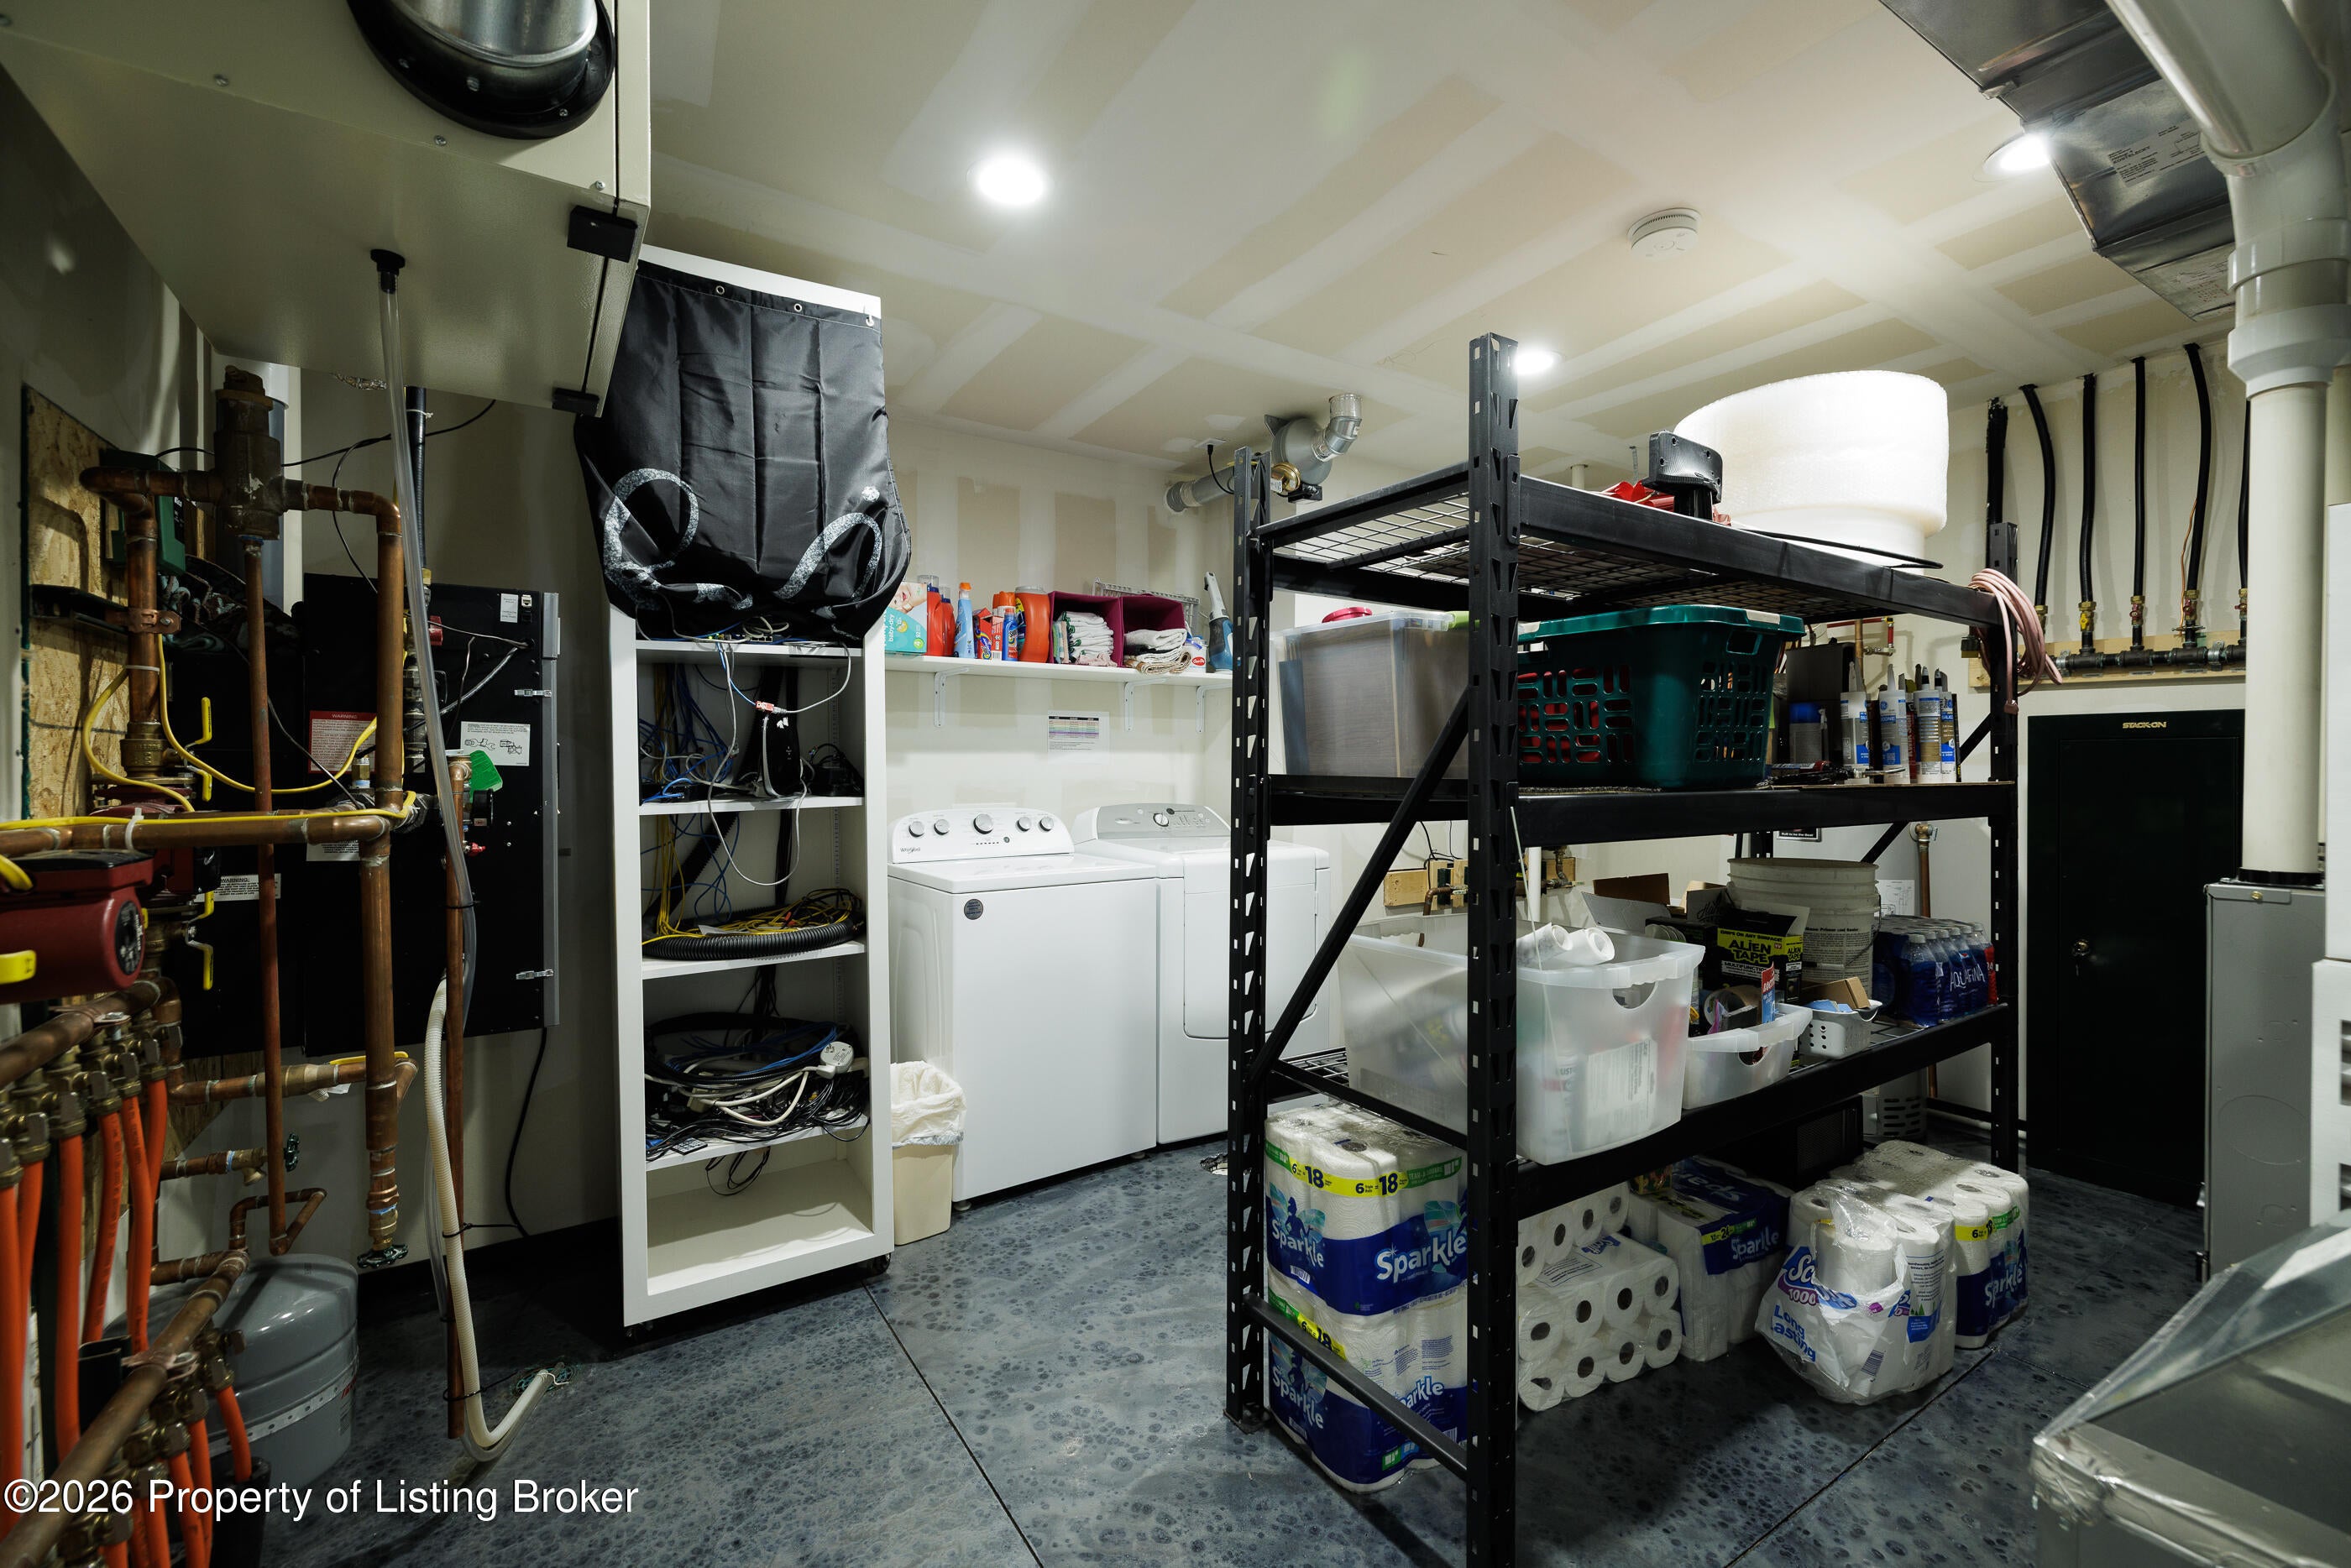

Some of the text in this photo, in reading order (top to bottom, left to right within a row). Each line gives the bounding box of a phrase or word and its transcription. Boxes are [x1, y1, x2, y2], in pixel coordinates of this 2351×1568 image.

[900, 846, 921, 855] Whirlpool
[1733, 949, 1768, 963] TAPE
[1950, 963, 1986, 992] AQUAFINA
[1292, 1163, 1298, 1175] 6
[1305, 1166, 1324, 1189] 18
[1355, 1183, 1364, 1194] 6
[1379, 1173, 1398, 1195] 18
[1272, 1219, 1325, 1268] Sparkle
[1731, 1226, 1780, 1261] Sparkle
[1971, 1230, 1979, 1239] 6
[1377, 1231, 1468, 1283] Sparkle
[1788, 1288, 1818, 1306] 1000
[1984, 1265, 2023, 1309] Sparkle
[1301, 1320, 1307, 1330] 6
[1773, 1304, 1805, 1341] Long
[1272, 1366, 1324, 1429] Sparkle
[1402, 1378, 1444, 1411] arkle
